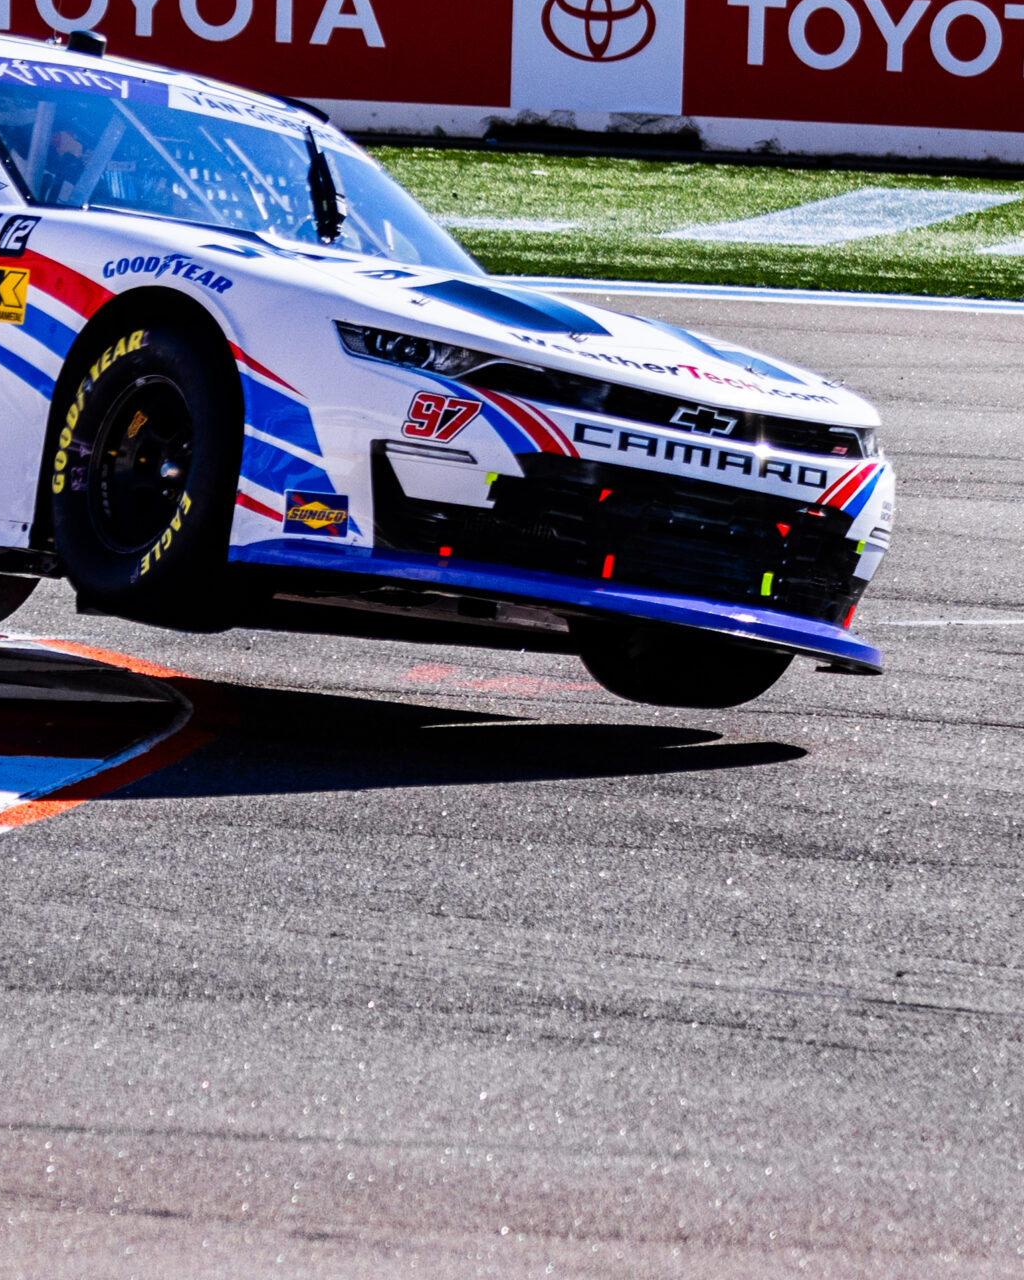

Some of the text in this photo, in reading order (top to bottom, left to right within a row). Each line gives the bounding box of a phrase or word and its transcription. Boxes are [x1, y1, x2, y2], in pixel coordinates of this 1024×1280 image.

[182, 91, 237, 115] VAN
[102, 253, 234, 295] GOODYEAR
[508, 331, 840, 405] WeatherTech.com
[52, 329, 144, 494] GOODYEAR
[401, 390, 483, 444] 97
[573, 422, 827, 489] CAMARO
[139, 490, 193, 576] EAGLE
[287, 506, 348, 525] SUNOCO
